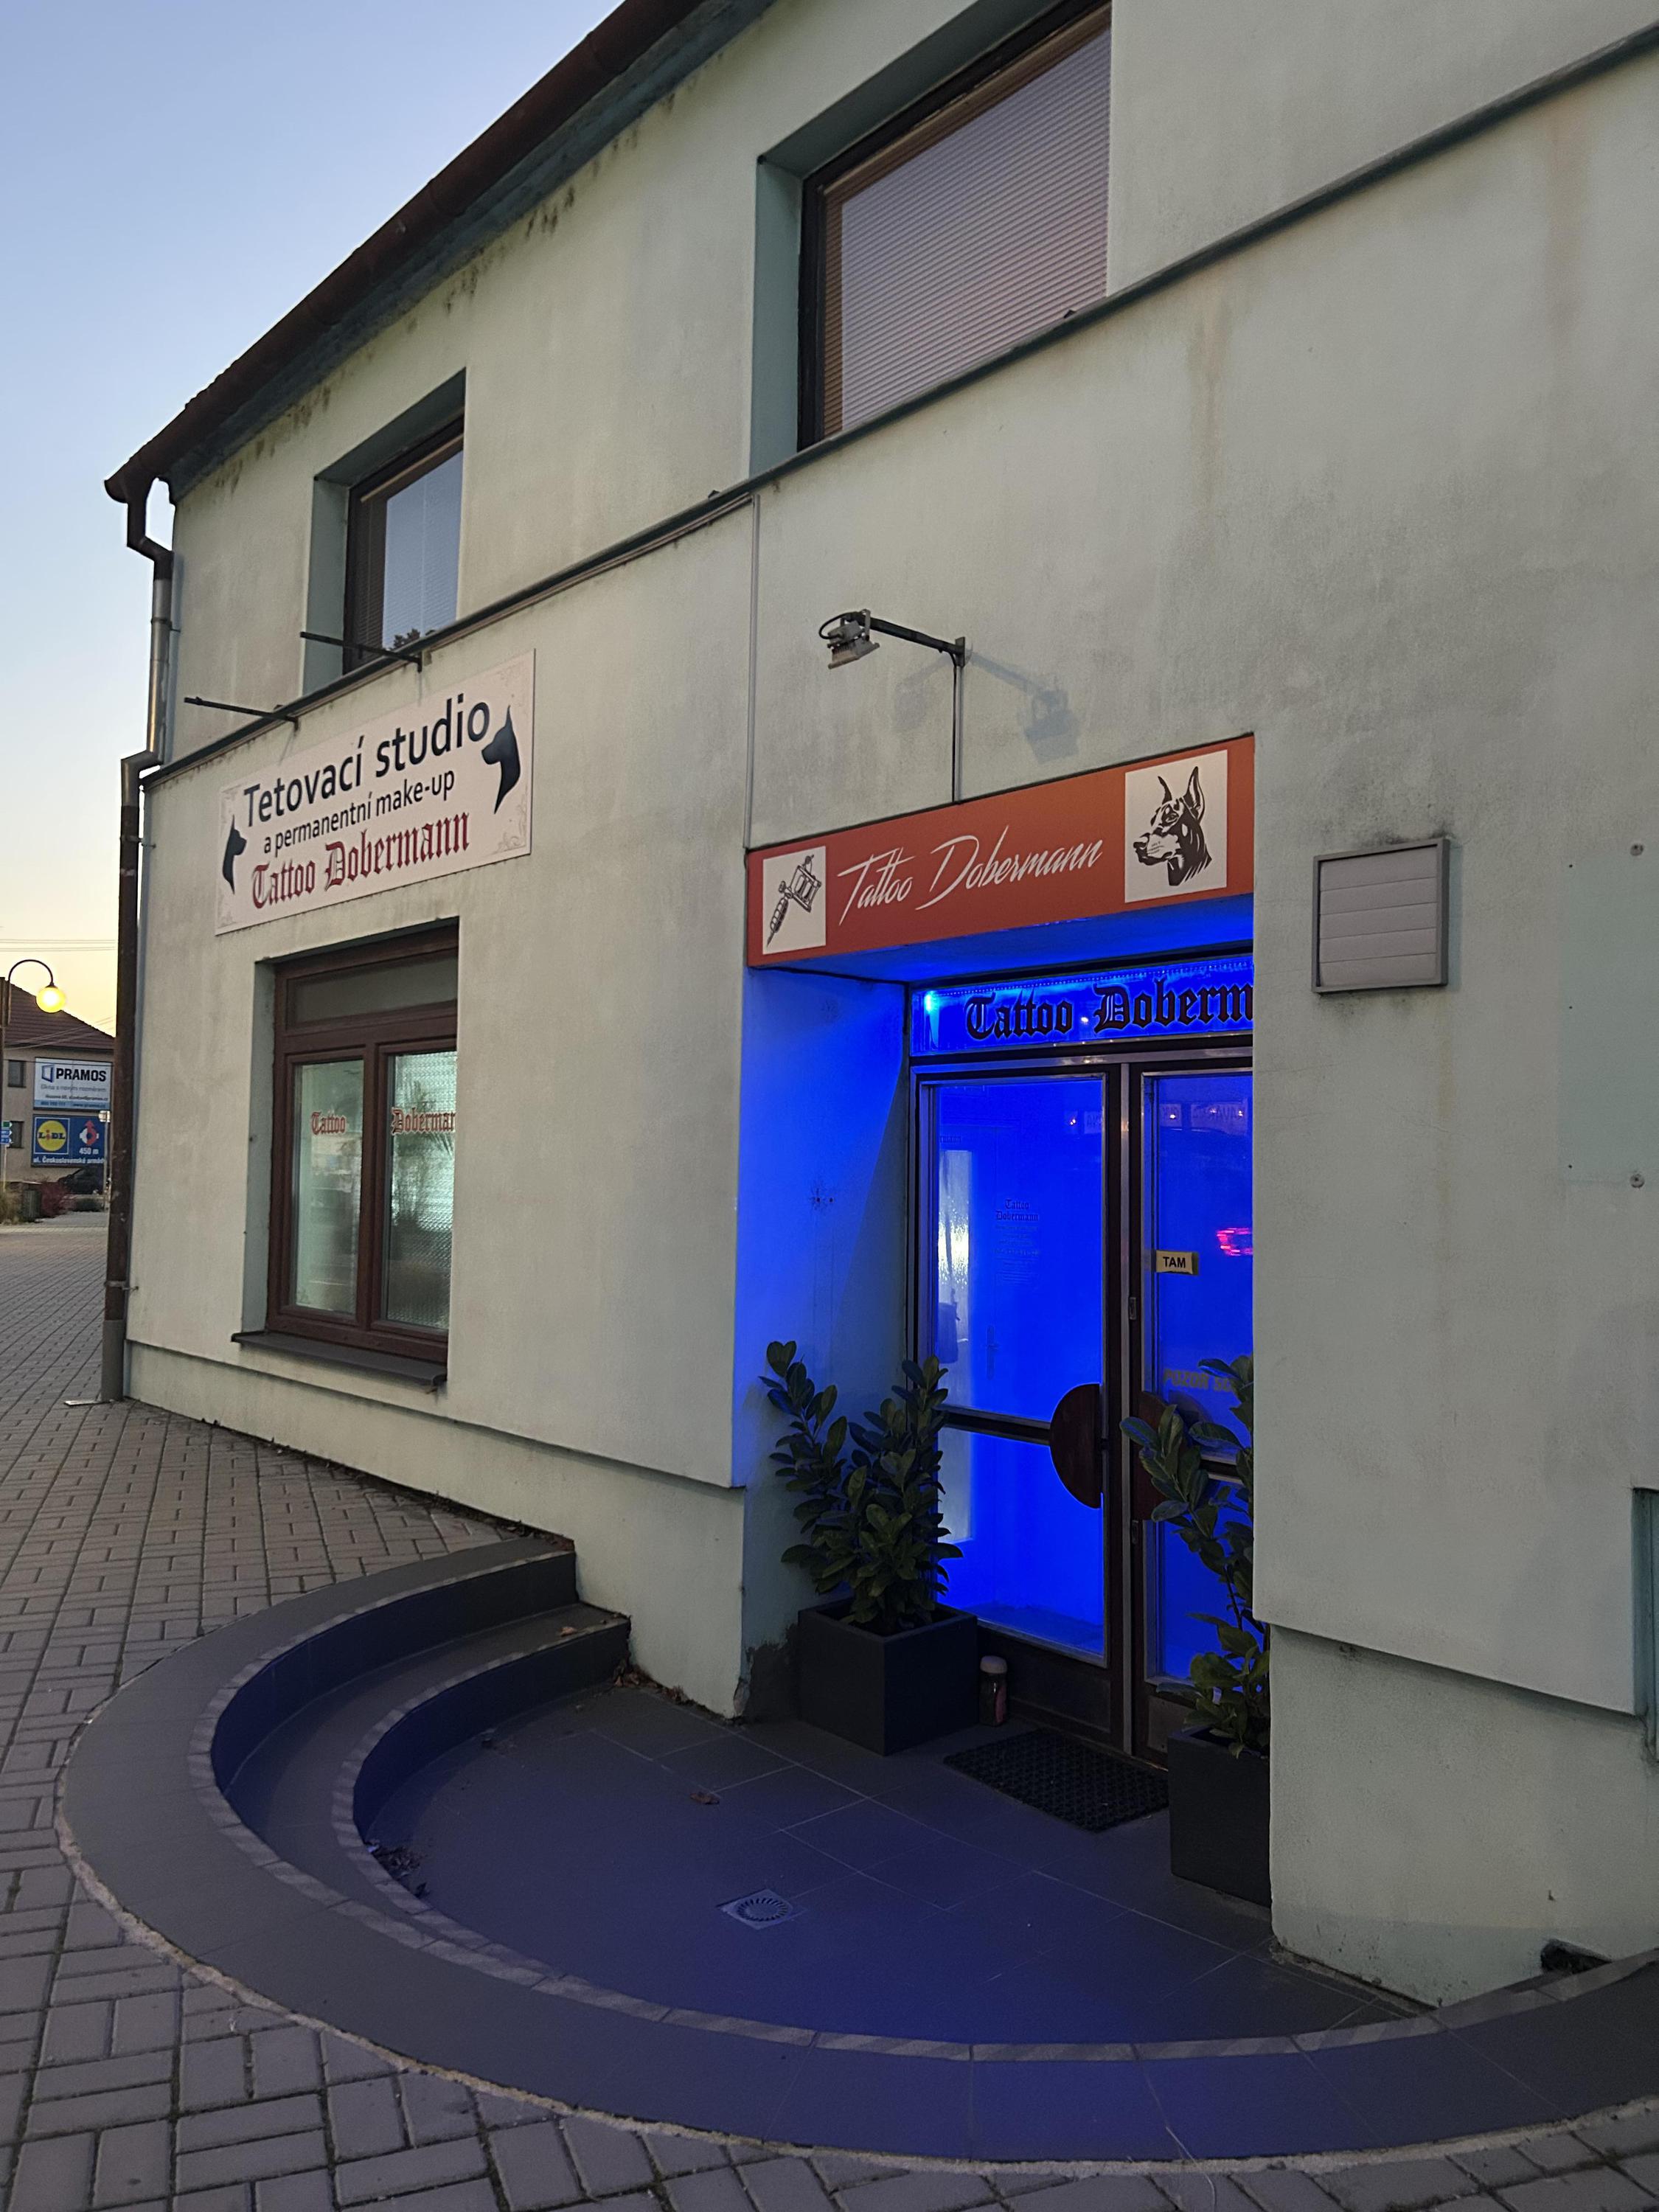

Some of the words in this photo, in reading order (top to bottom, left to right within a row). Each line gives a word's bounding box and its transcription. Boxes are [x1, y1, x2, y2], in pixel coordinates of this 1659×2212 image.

[244, 735, 364, 827] Tetovací
[375, 693, 490, 777] studio
[263, 835, 271, 854] a
[275, 792, 372, 858] permanentní
[376, 770, 455, 816] make-up
[251, 859, 316, 909] Tattoo
[324, 812, 470, 891] Dobermann
[838, 847, 915, 925] Tattoo
[915, 825, 1103, 910] Dobermann
[966, 988, 1073, 1040] Tattoo
[56, 1067, 107, 1082] PRAMOS
[311, 1111, 346, 1135] Tattoo
[1163, 1256, 1186, 1268] TAM
